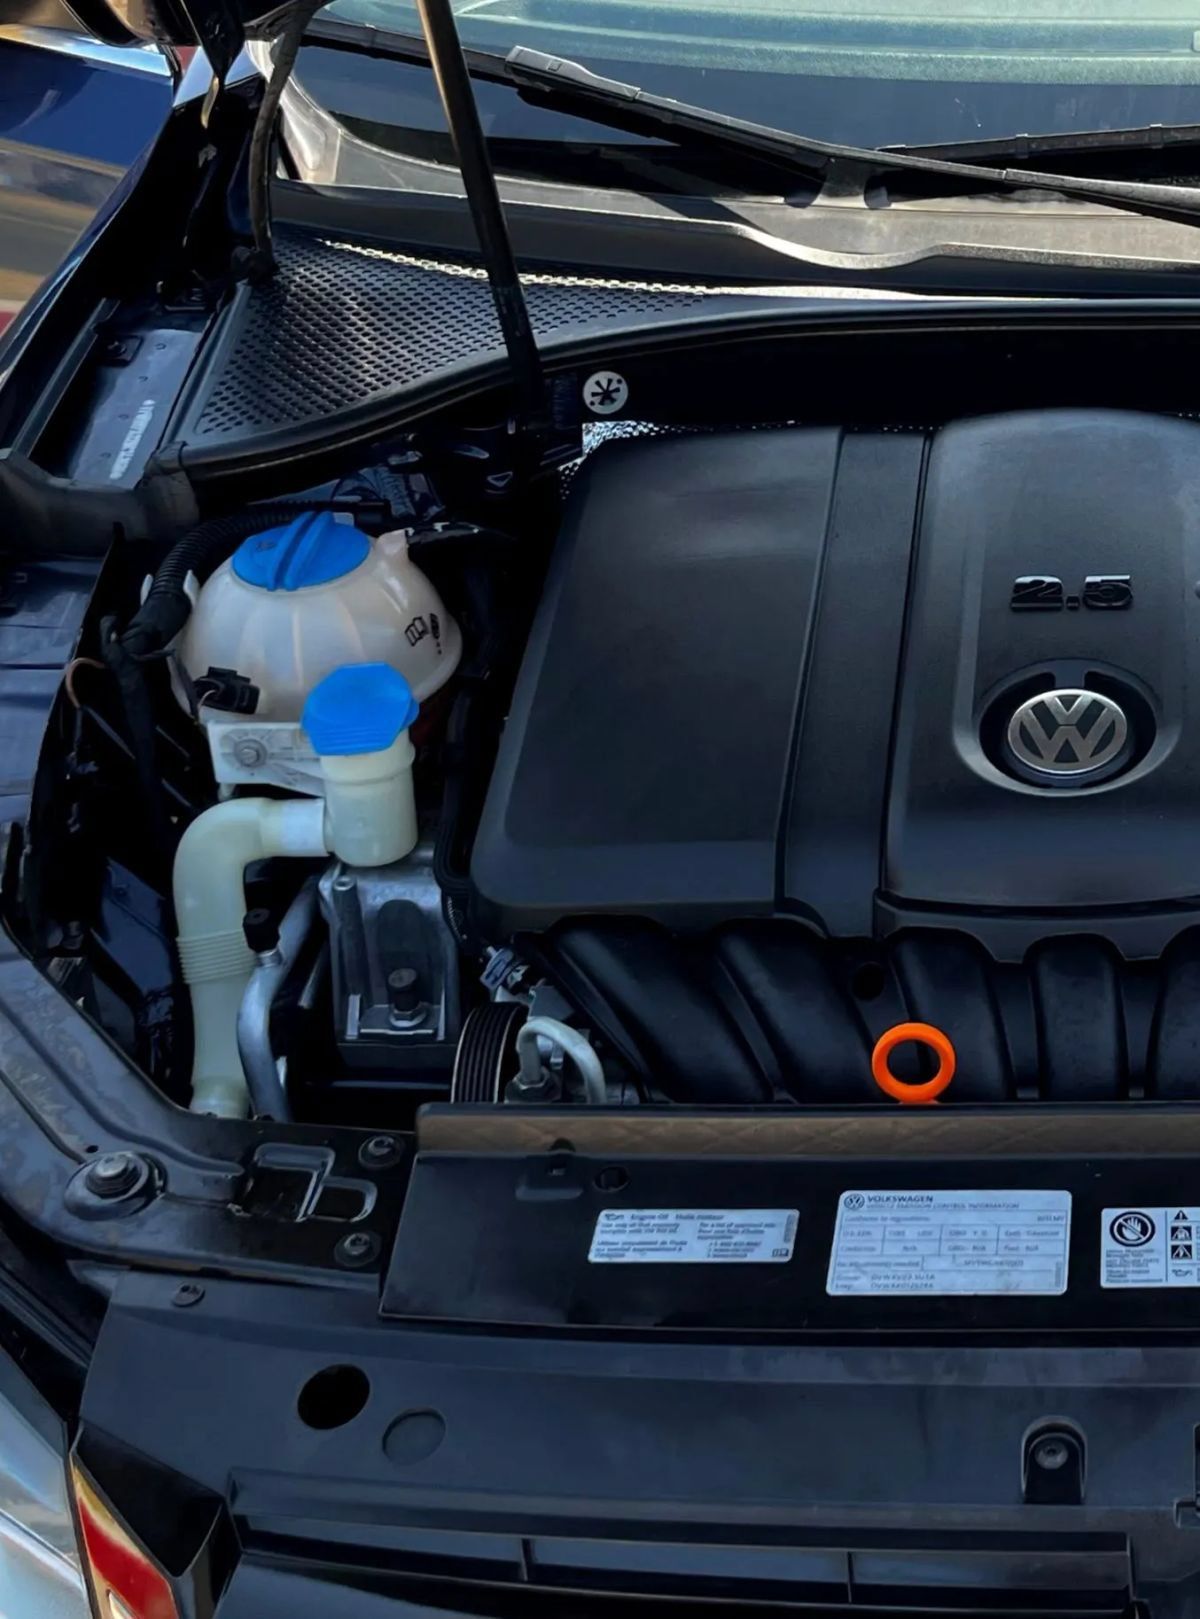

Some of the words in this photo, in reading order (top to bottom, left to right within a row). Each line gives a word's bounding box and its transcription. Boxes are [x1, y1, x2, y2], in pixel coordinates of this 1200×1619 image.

[1010, 574, 1134, 611] 2.5
[1007, 688, 1128, 775] VW
[867, 1195, 933, 1203] VOLKSWAGEN
